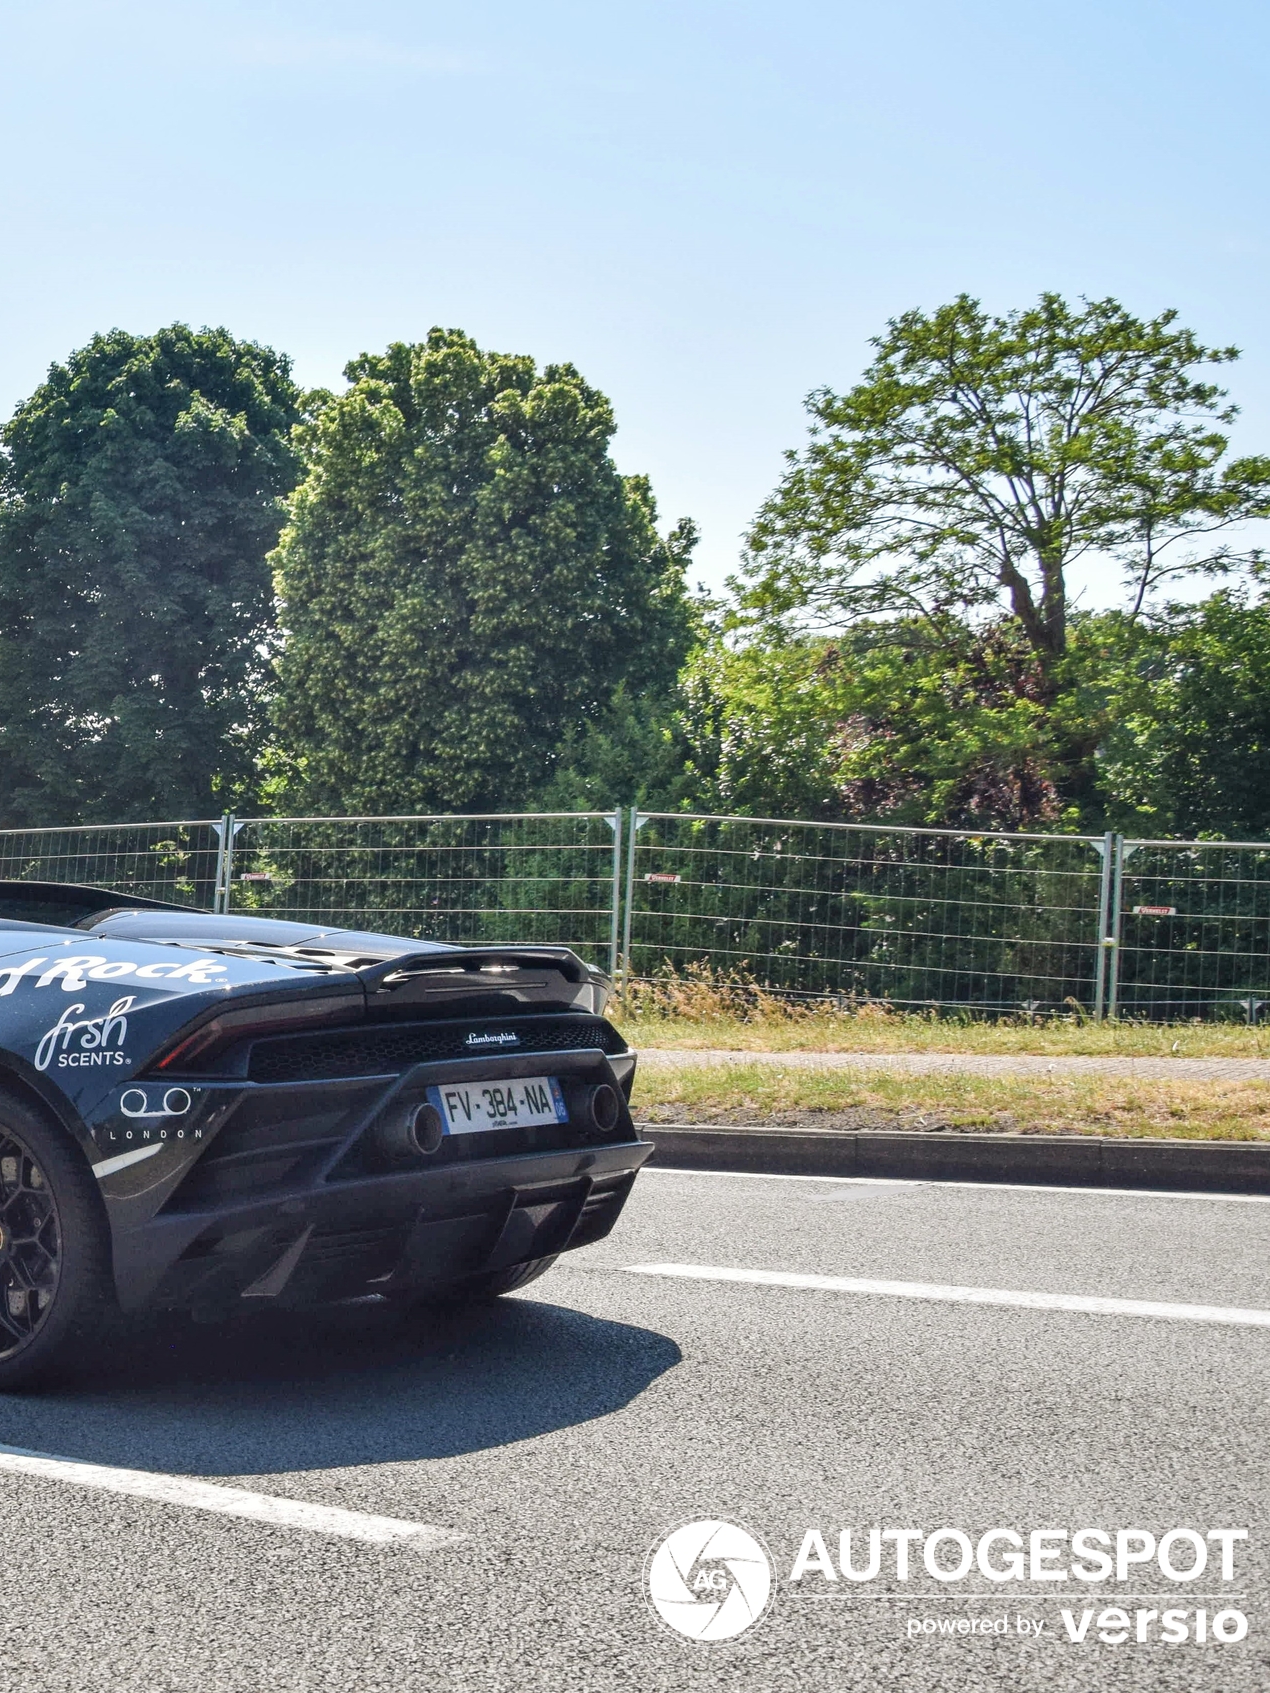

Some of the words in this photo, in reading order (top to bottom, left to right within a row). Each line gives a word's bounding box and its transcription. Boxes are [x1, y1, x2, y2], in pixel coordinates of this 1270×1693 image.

[35, 955, 228, 992] Rock
[465, 1032, 517, 1045] Lamborghini
[58, 1051, 124, 1067] SCENTS
[110, 1129, 202, 1140] LONDON
